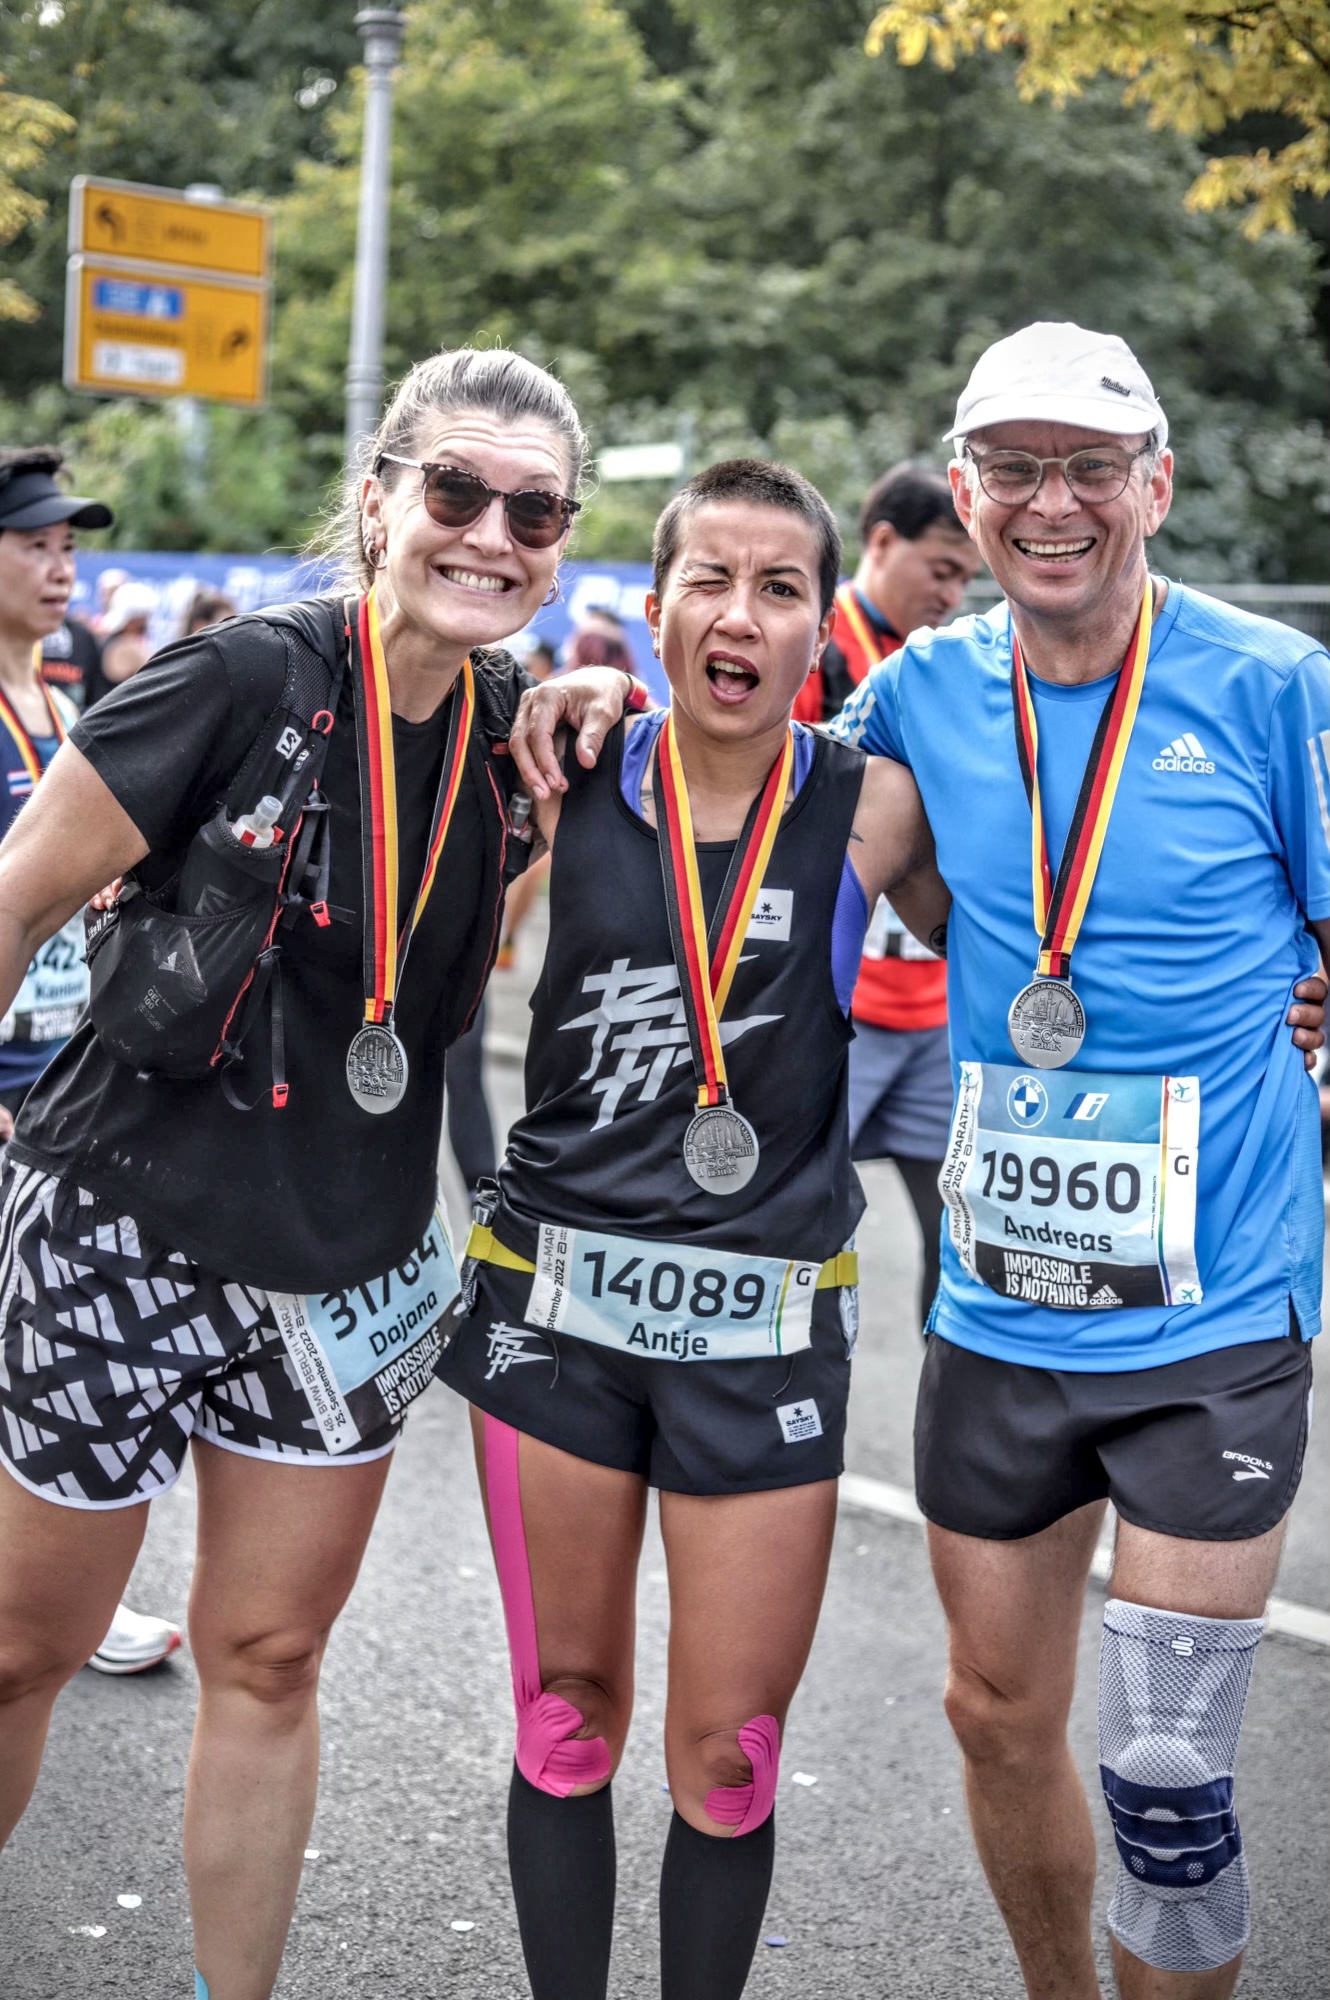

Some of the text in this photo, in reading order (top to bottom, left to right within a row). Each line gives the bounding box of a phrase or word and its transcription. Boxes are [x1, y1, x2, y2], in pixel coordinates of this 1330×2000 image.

[1152, 756, 1216, 775] adidas
[143, 995, 155, 1010] 100
[147, 988, 160, 1007] GEL
[1012, 1078, 1042, 1094] BMW
[706, 1156, 737, 1170] SCC
[952, 1161, 968, 1188] 2022
[1174, 1155, 1189, 1176] G
[982, 1150, 1141, 1214] 19960
[953, 1207, 962, 1239] BMW
[954, 1191, 972, 1245] September
[1004, 1215, 1113, 1253] Andreas
[554, 1259, 565, 1287] 2022
[796, 1267, 812, 1286] G
[1003, 1252, 1093, 1285] IMPOSSIBLE
[583, 1250, 766, 1321] 14089
[1005, 1273, 1088, 1306] IS NOTHING
[1089, 1296, 1123, 1306] adidas
[368, 1290, 438, 1358] Dajana
[626, 1322, 709, 1361] Antje
[374, 1326, 441, 1396] IMPOSSIBLE
[300, 1329, 347, 1428] 25. September 2022
[310, 1385, 328, 1415] BMW
[383, 1391, 401, 1415] IS
[323, 1413, 335, 1432] 48.
[786, 1414, 814, 1427] SAYSKY
[1222, 1450, 1273, 1470] BROOKS
